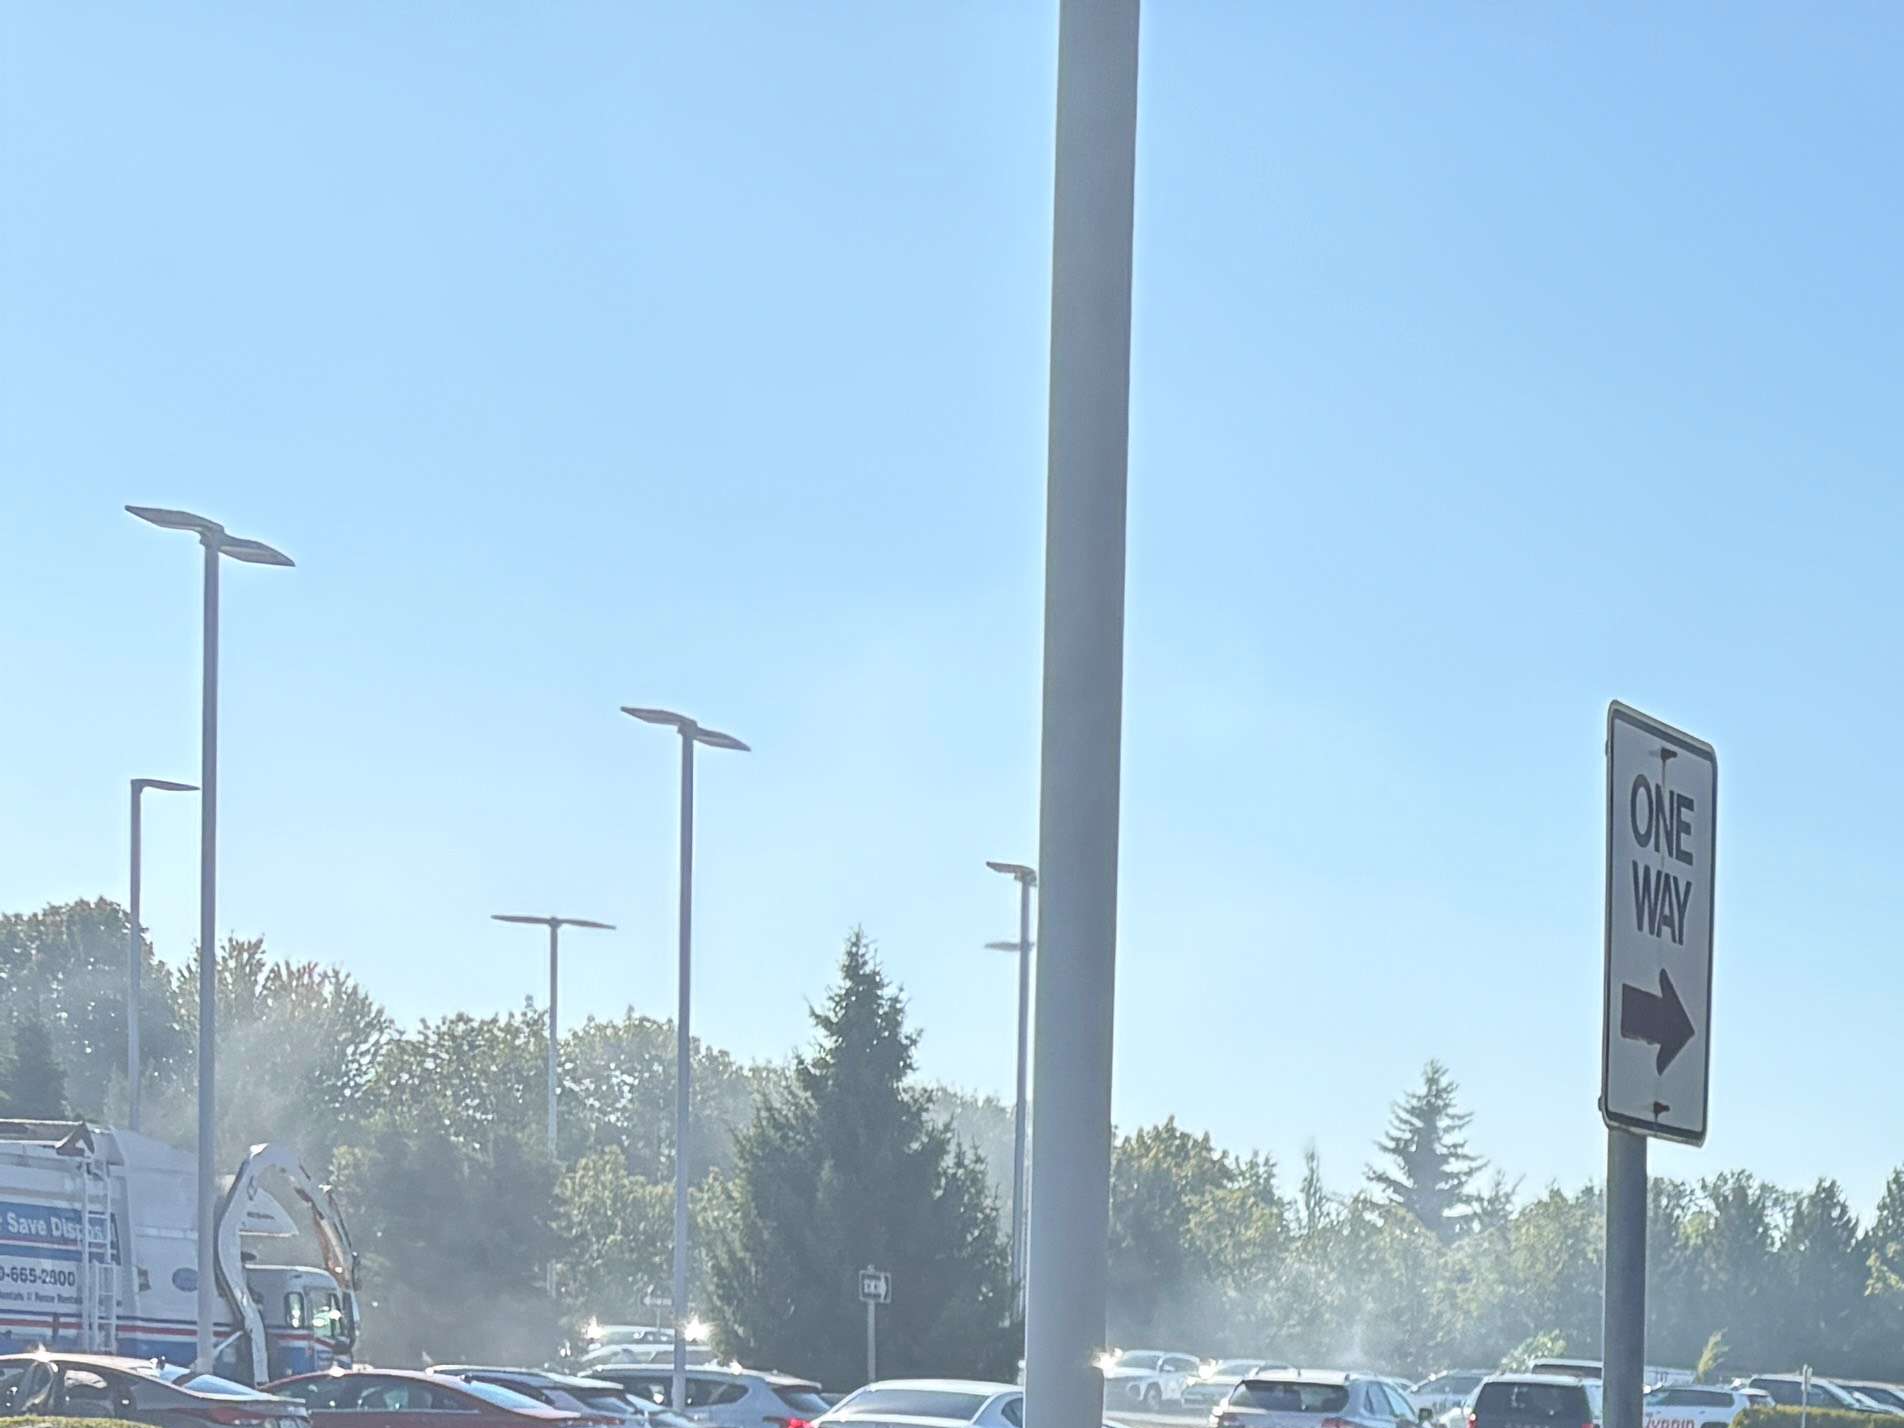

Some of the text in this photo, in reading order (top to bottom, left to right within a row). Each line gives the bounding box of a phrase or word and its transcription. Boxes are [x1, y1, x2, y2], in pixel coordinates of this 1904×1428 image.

[1631, 774, 1694, 866] ONE
[1632, 860, 1692, 946] WAY
[7, 1212, 47, 1235] Save
